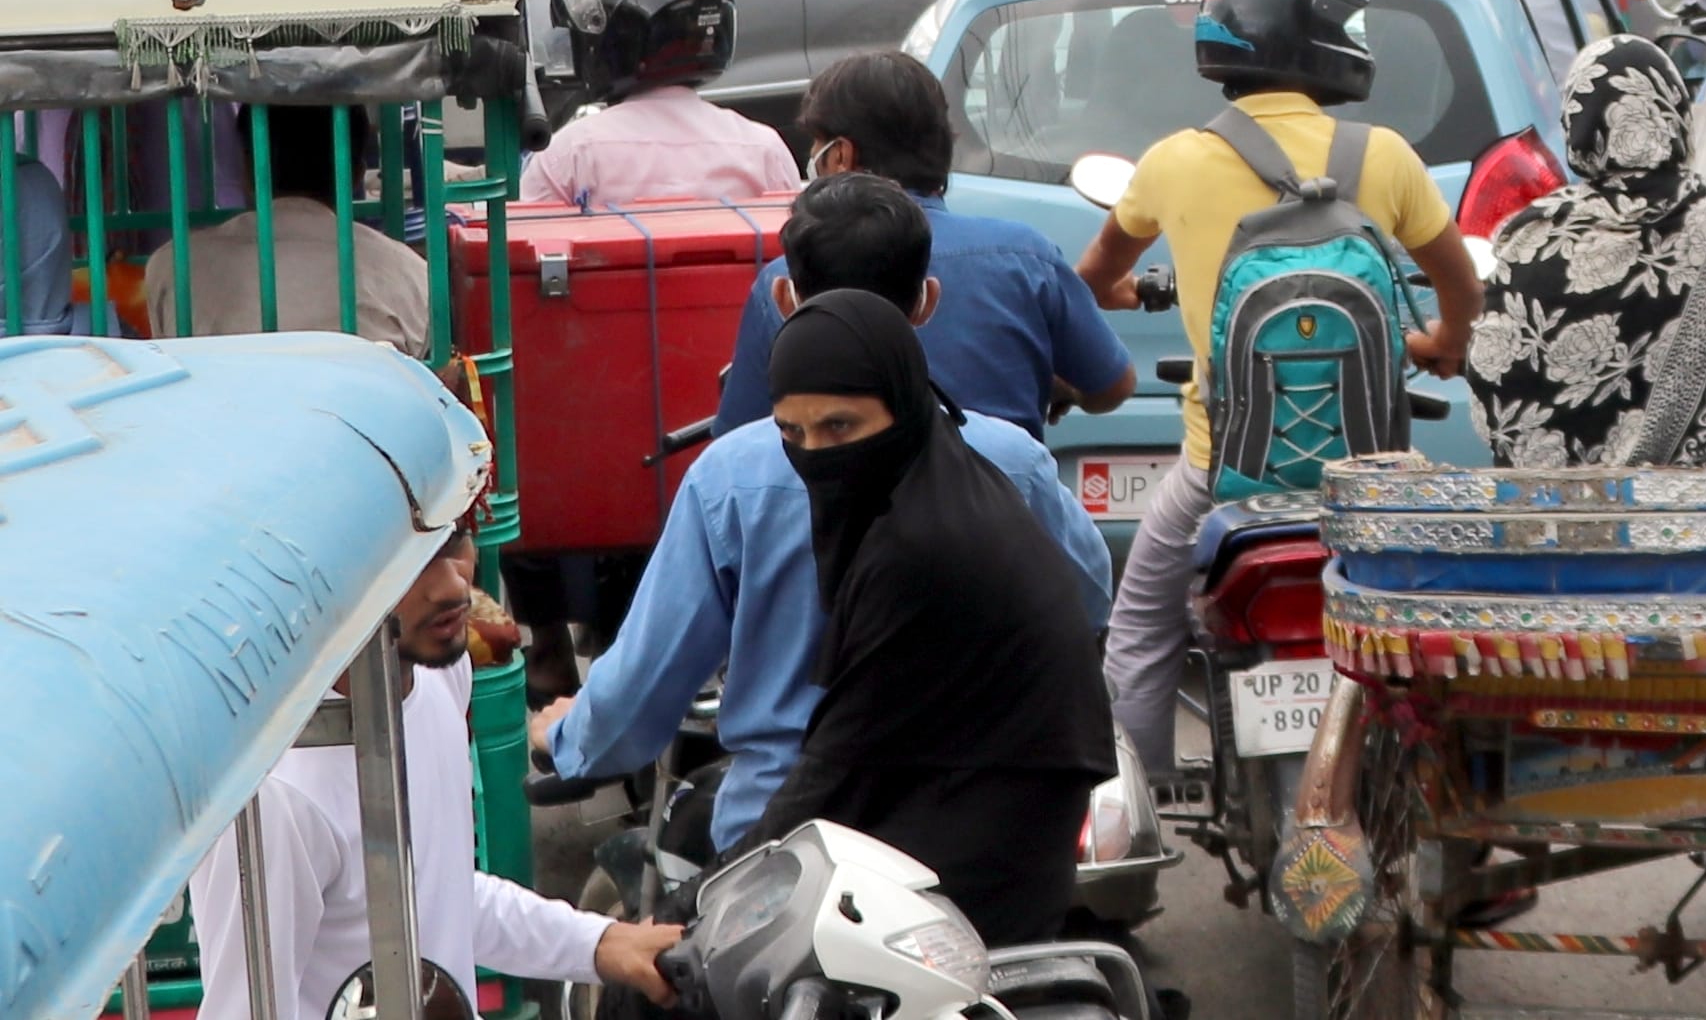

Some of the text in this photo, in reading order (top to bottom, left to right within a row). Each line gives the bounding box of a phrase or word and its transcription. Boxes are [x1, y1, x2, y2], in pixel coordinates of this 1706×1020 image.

[1110, 476, 1147, 503] UP
[1252, 674, 1283, 697] UP
[1292, 672, 1320, 695] 20
